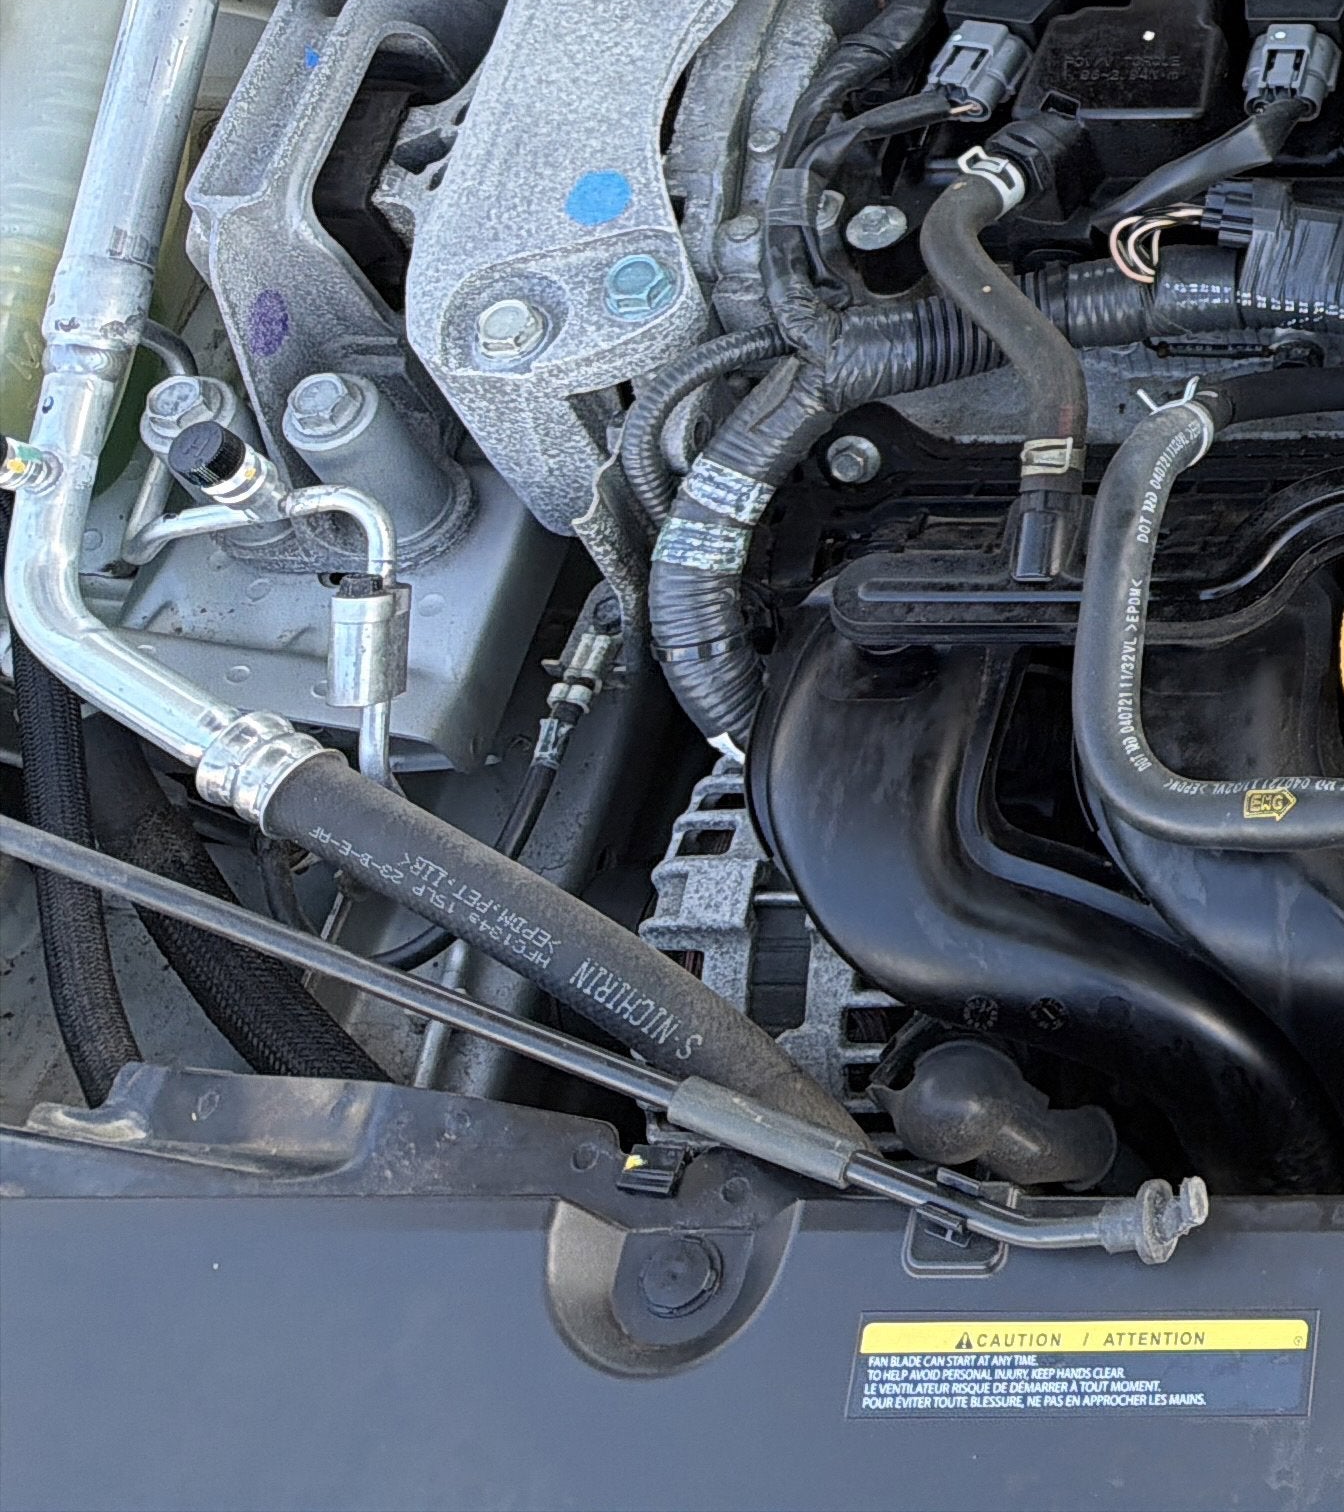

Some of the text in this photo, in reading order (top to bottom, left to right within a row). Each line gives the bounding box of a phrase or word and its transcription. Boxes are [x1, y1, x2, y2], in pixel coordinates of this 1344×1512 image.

[1136, 516, 1152, 544] DOT
[1118, 692, 1135, 734] 040721
[975, 1331, 1062, 1348] CAUTION
[1102, 1330, 1207, 1347] ATTENTION
[868, 1356, 889, 1367] FAN
[890, 1356, 922, 1367] BLADE
[923, 1356, 946, 1367] CAN
[947, 1355, 976, 1366] START
[977, 1355, 990, 1366] AT
[991, 1355, 1014, 1366] ANY
[867, 1370, 882, 1380] TO
[883, 1370, 908, 1380] HELP
[909, 1369, 941, 1380] AVOID
[942, 1369, 992, 1380] PERSONAL
[1031, 1368, 1055, 1379] KEEP
[1056, 1368, 1091, 1379] HANDS
[864, 1384, 878, 1394] LE
[879, 1383, 950, 1394] VENTILATEUR
[951, 1383, 991, 1395] RISQUE
[993, 1383, 1009, 1393] DE
[1080, 1382, 1110, 1392] TOUT
[1110, 1381, 1161, 1392] MOMENT.
[862, 1397, 894, 1408] POUR
[895, 1396, 931, 1408] ÉVITER
[933, 1397, 968, 1408] TOUTE
[1027, 1396, 1041, 1407] NE
[1043, 1395, 1064, 1407] PAS
[1065, 1395, 1080, 1406] EN
[1082, 1395, 1147, 1406] APPROCHER
[1148, 1394, 1167, 1406] LES
